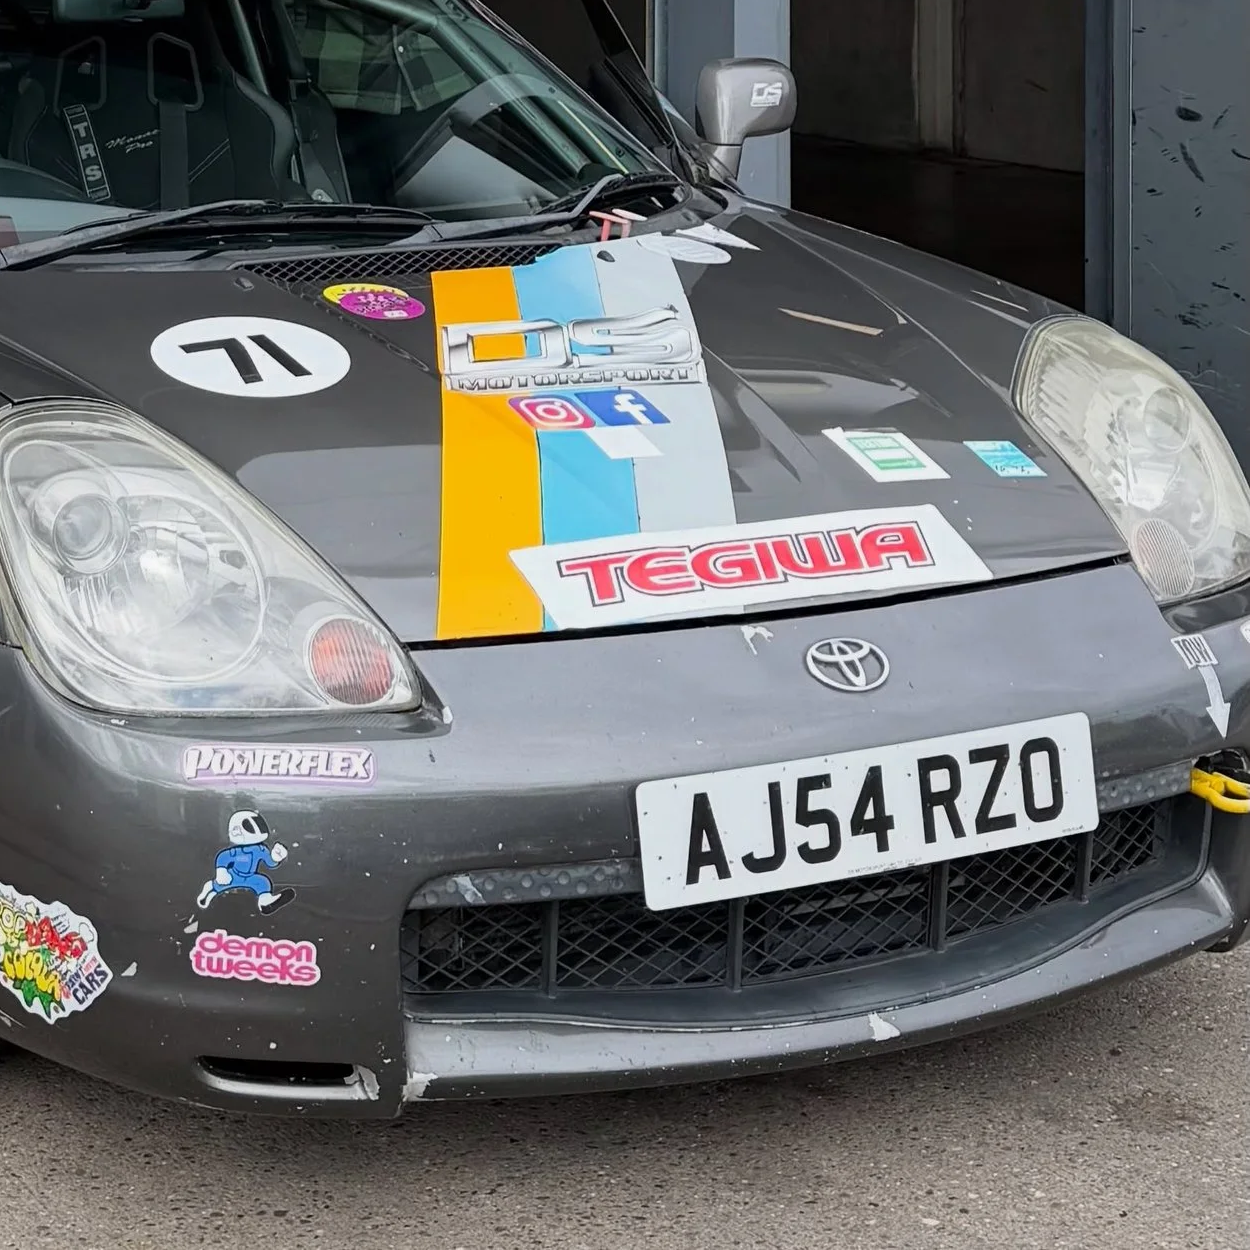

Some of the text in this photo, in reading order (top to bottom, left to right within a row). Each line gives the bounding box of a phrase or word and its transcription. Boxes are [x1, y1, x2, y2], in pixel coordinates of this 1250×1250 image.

[72, 121, 103, 182] TRS
[177, 333, 313, 385] 71
[441, 304, 702, 376] DS
[456, 366, 694, 391] MOTORSPORT
[555, 519, 938, 608] TEGIWA
[184, 747, 373, 780] POWERFLEX
[684, 735, 1066, 887] AJ54 RZO
[192, 949, 318, 982] tweeks
[198, 932, 313, 963] demon
[71, 964, 109, 1005] CARS
